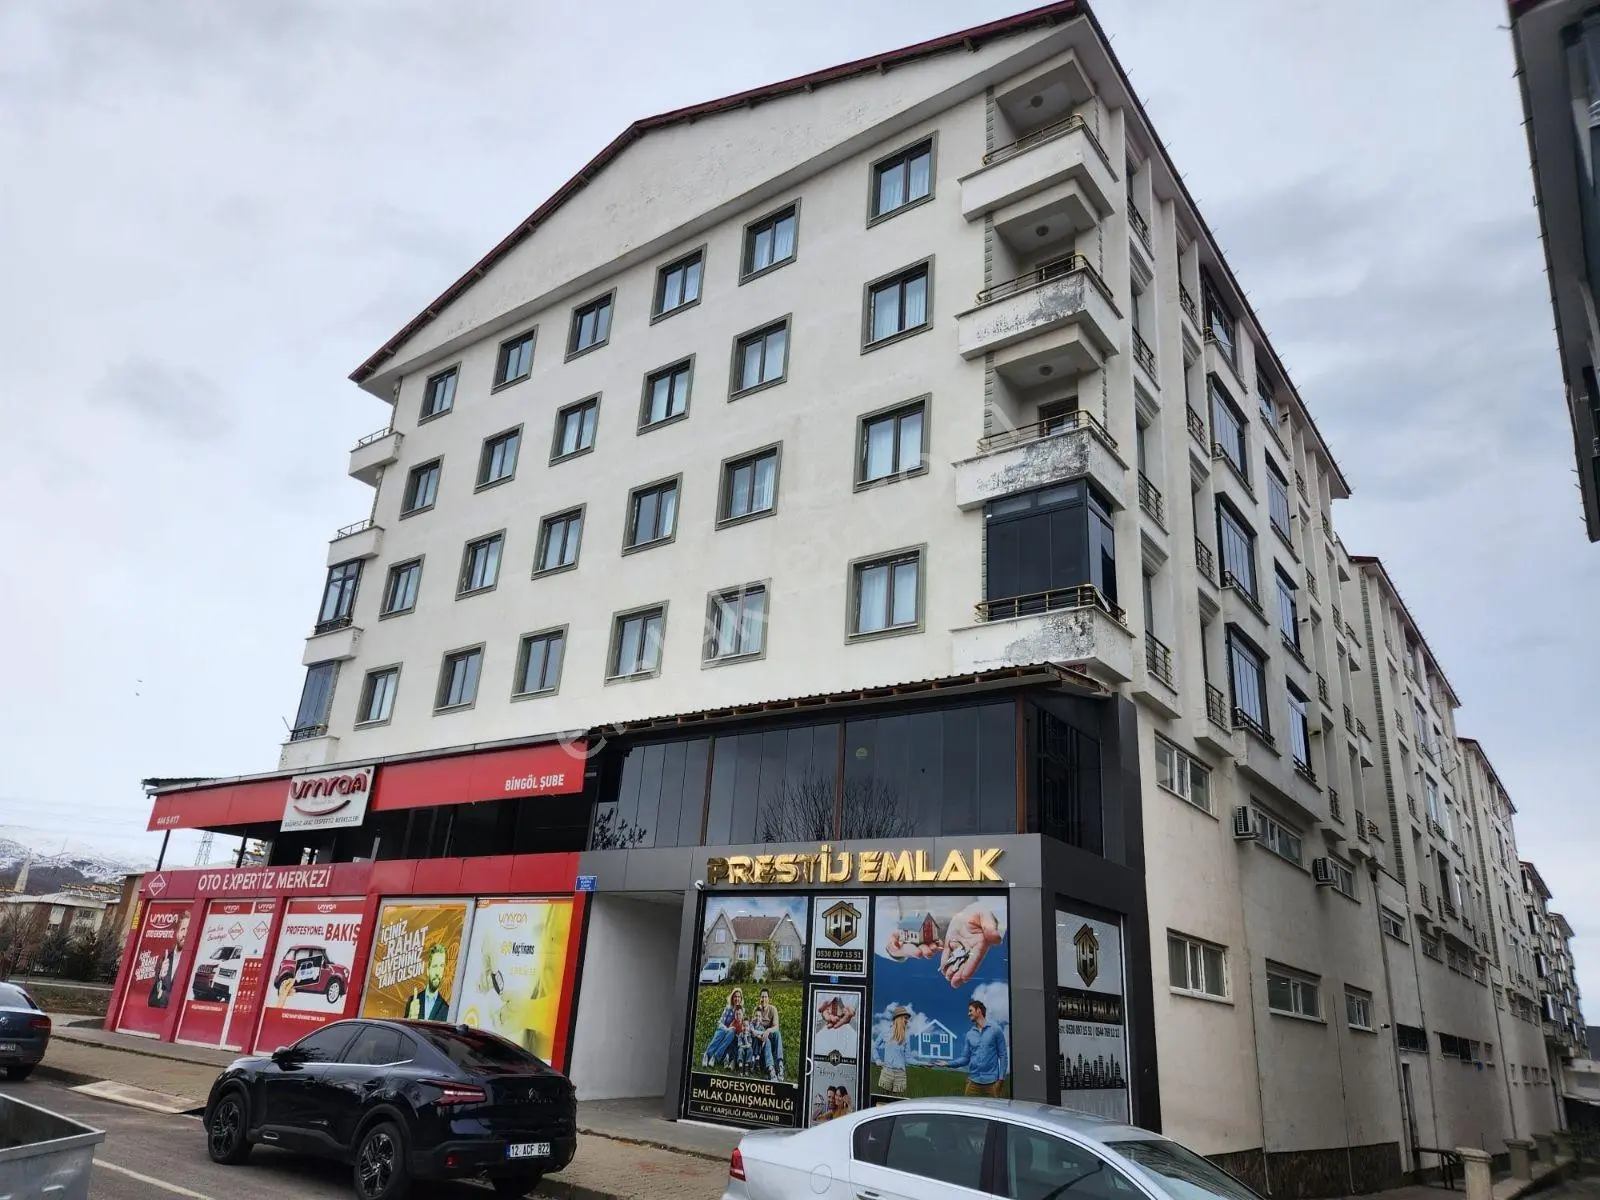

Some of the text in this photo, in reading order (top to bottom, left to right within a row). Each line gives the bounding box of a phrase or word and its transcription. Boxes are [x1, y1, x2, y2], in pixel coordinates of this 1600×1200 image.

[505, 774, 565, 791] BİNGÖL ŞUBE
[707, 844, 1008, 884] PRESTİJ EMLAK
[198, 874, 221, 891] OTO
[276, 866, 332, 889] MERKEZİ
[286, 923, 360, 946] PROFESYONEL BAKIŞ
[380, 918, 408, 944] İÇİNİZ
[387, 925, 429, 957] RAHAT
[379, 962, 425, 989] TAM OLSUN
[710, 1078, 776, 1096] PROFESYONEL
[692, 1088, 794, 1111] EMLAK DANIŞMANLIĞI
[712, 1106, 741, 1117] KARŞILIĞI
[742, 1111, 758, 1119] ARSA
[759, 1113, 780, 1122] ALINIR
[511, 1145, 519, 1156] 12
[522, 1144, 534, 1155] ACF
